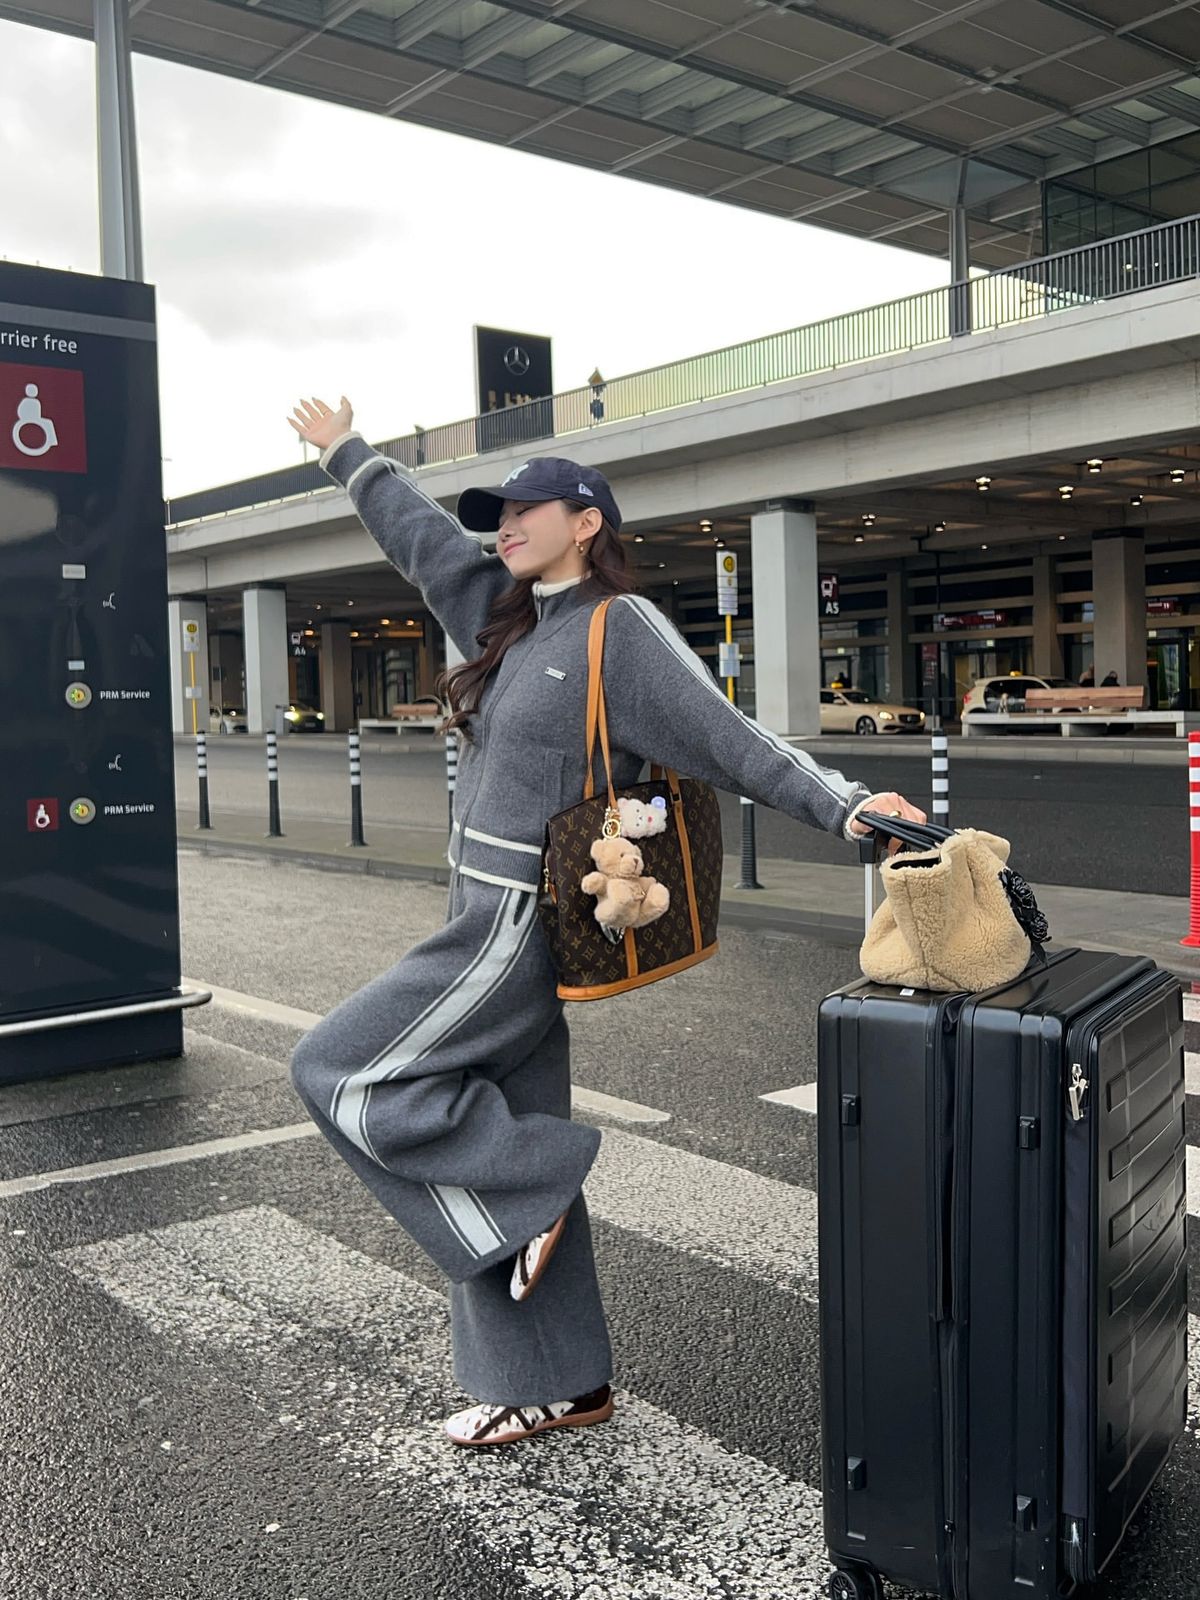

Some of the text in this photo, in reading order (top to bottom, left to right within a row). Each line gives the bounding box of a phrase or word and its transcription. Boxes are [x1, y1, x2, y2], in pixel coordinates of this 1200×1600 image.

[1, 330, 78, 354] rrier free
[825, 601, 840, 615] A5
[100, 690, 151, 700] PRM Service
[104, 802, 155, 815] PRM Service
